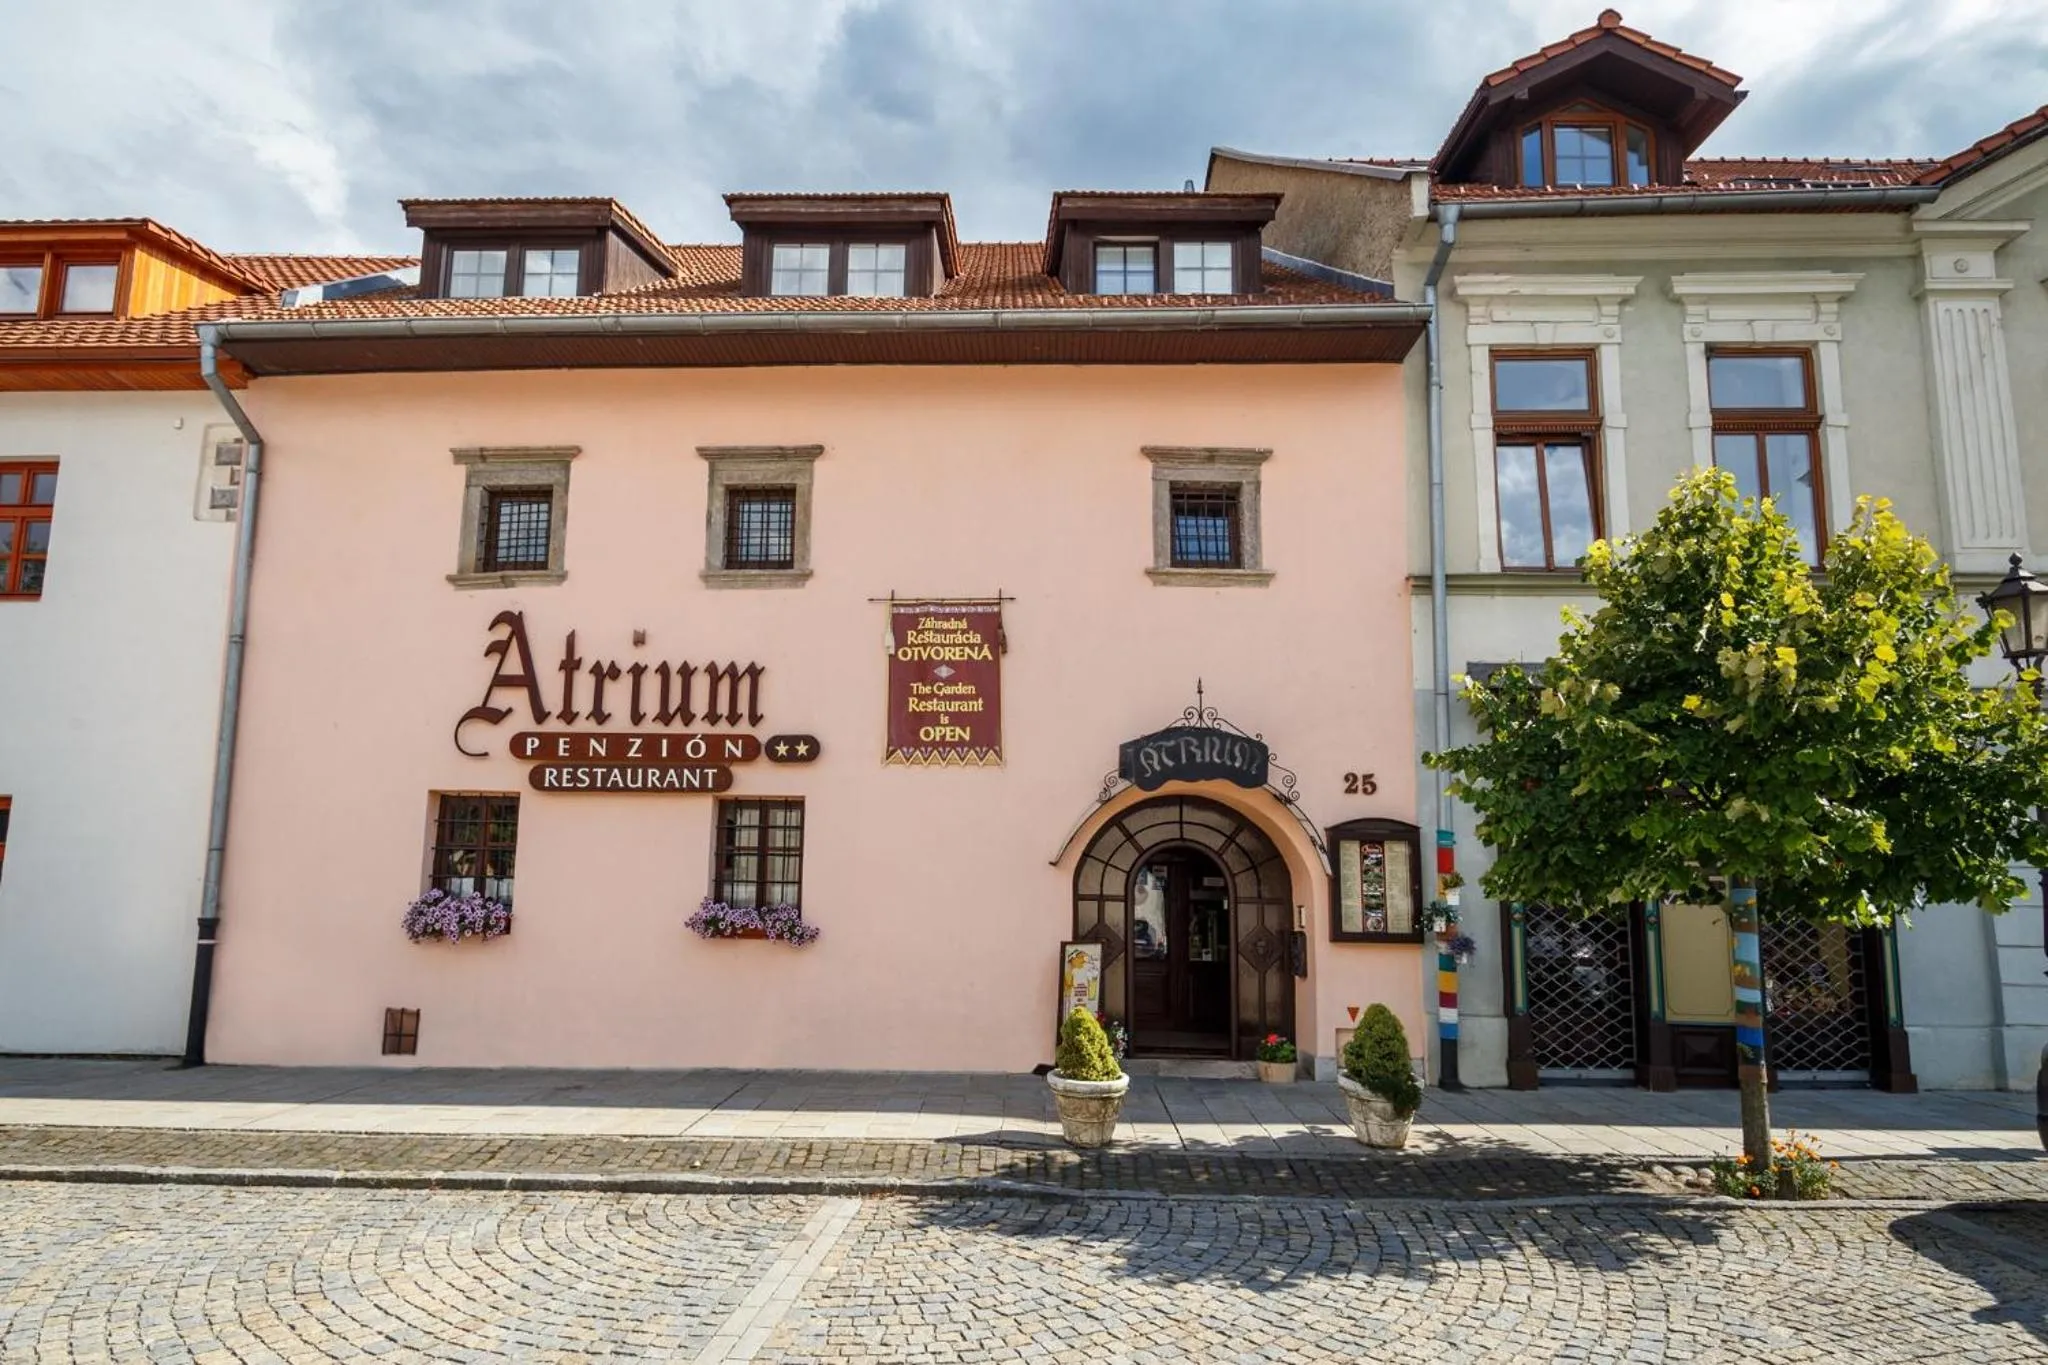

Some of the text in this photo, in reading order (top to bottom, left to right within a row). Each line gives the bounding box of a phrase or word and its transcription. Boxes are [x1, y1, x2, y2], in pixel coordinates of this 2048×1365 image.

[918, 617, 968, 630] Záhradná
[898, 644, 993, 661] OTVORENÁ
[454, 610, 766, 757] Atrium
[910, 682, 976, 697] The Garden
[908, 697, 984, 712] Restaurant
[940, 714, 949, 724] is
[919, 726, 971, 742] OPEN
[526, 734, 743, 759] PENZIÓN
[544, 767, 718, 789] RESTAURANT
[1344, 772, 1377, 796] 25
